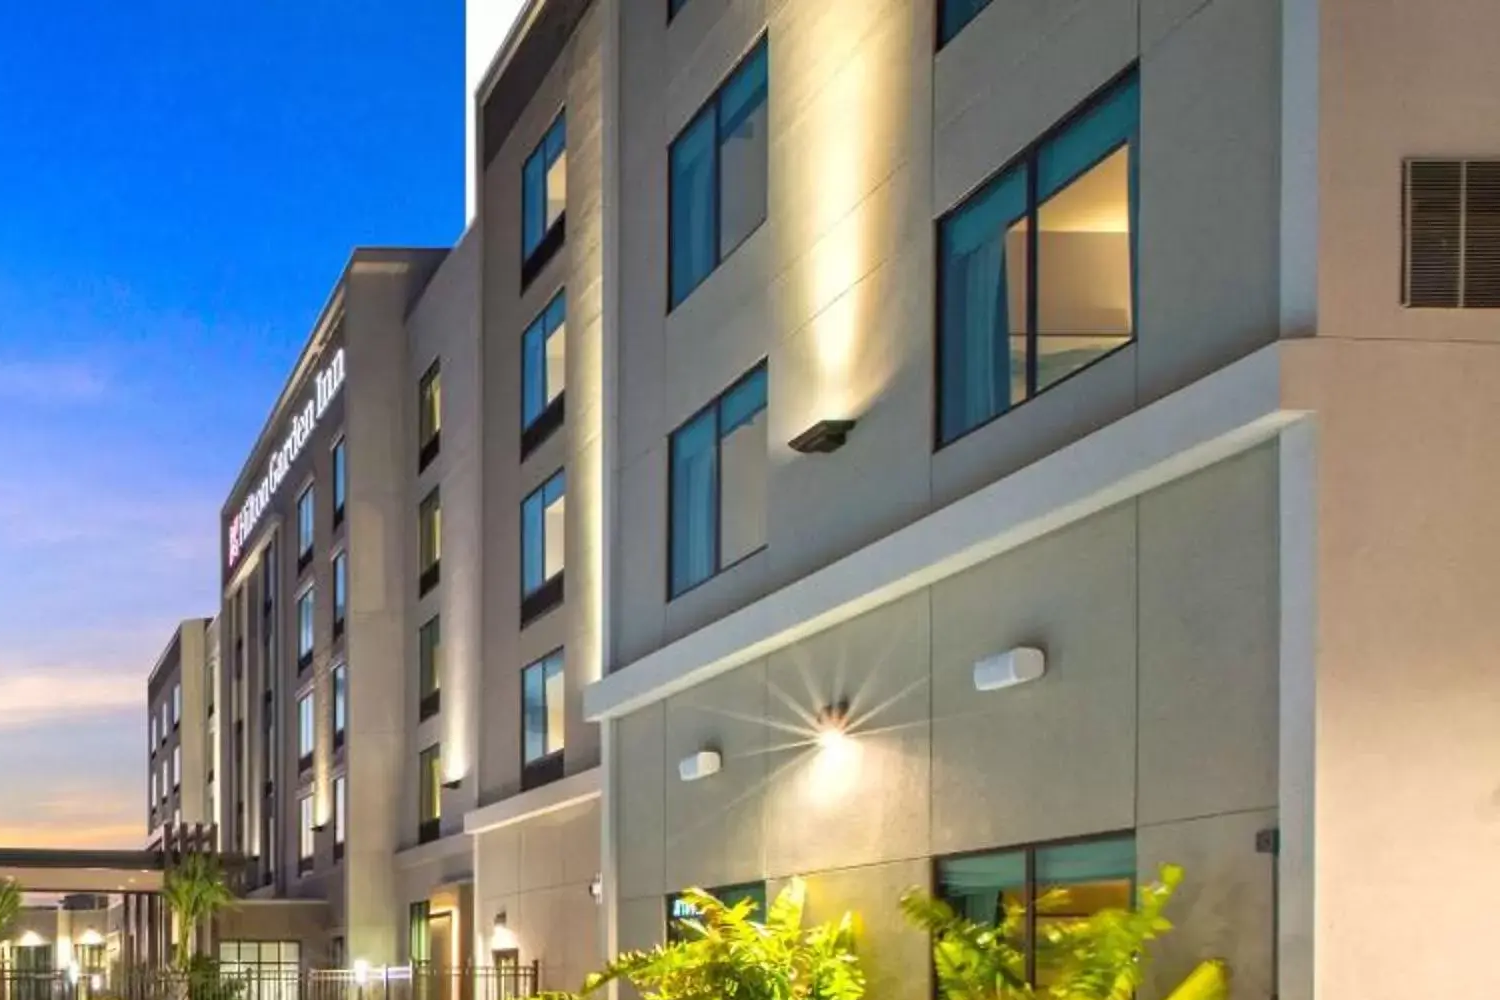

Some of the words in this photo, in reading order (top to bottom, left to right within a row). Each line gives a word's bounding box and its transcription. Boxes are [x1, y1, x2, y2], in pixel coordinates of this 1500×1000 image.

[238, 476, 271, 546] Hilton
[269, 400, 315, 494] Garden
[315, 348, 346, 420] Inn
